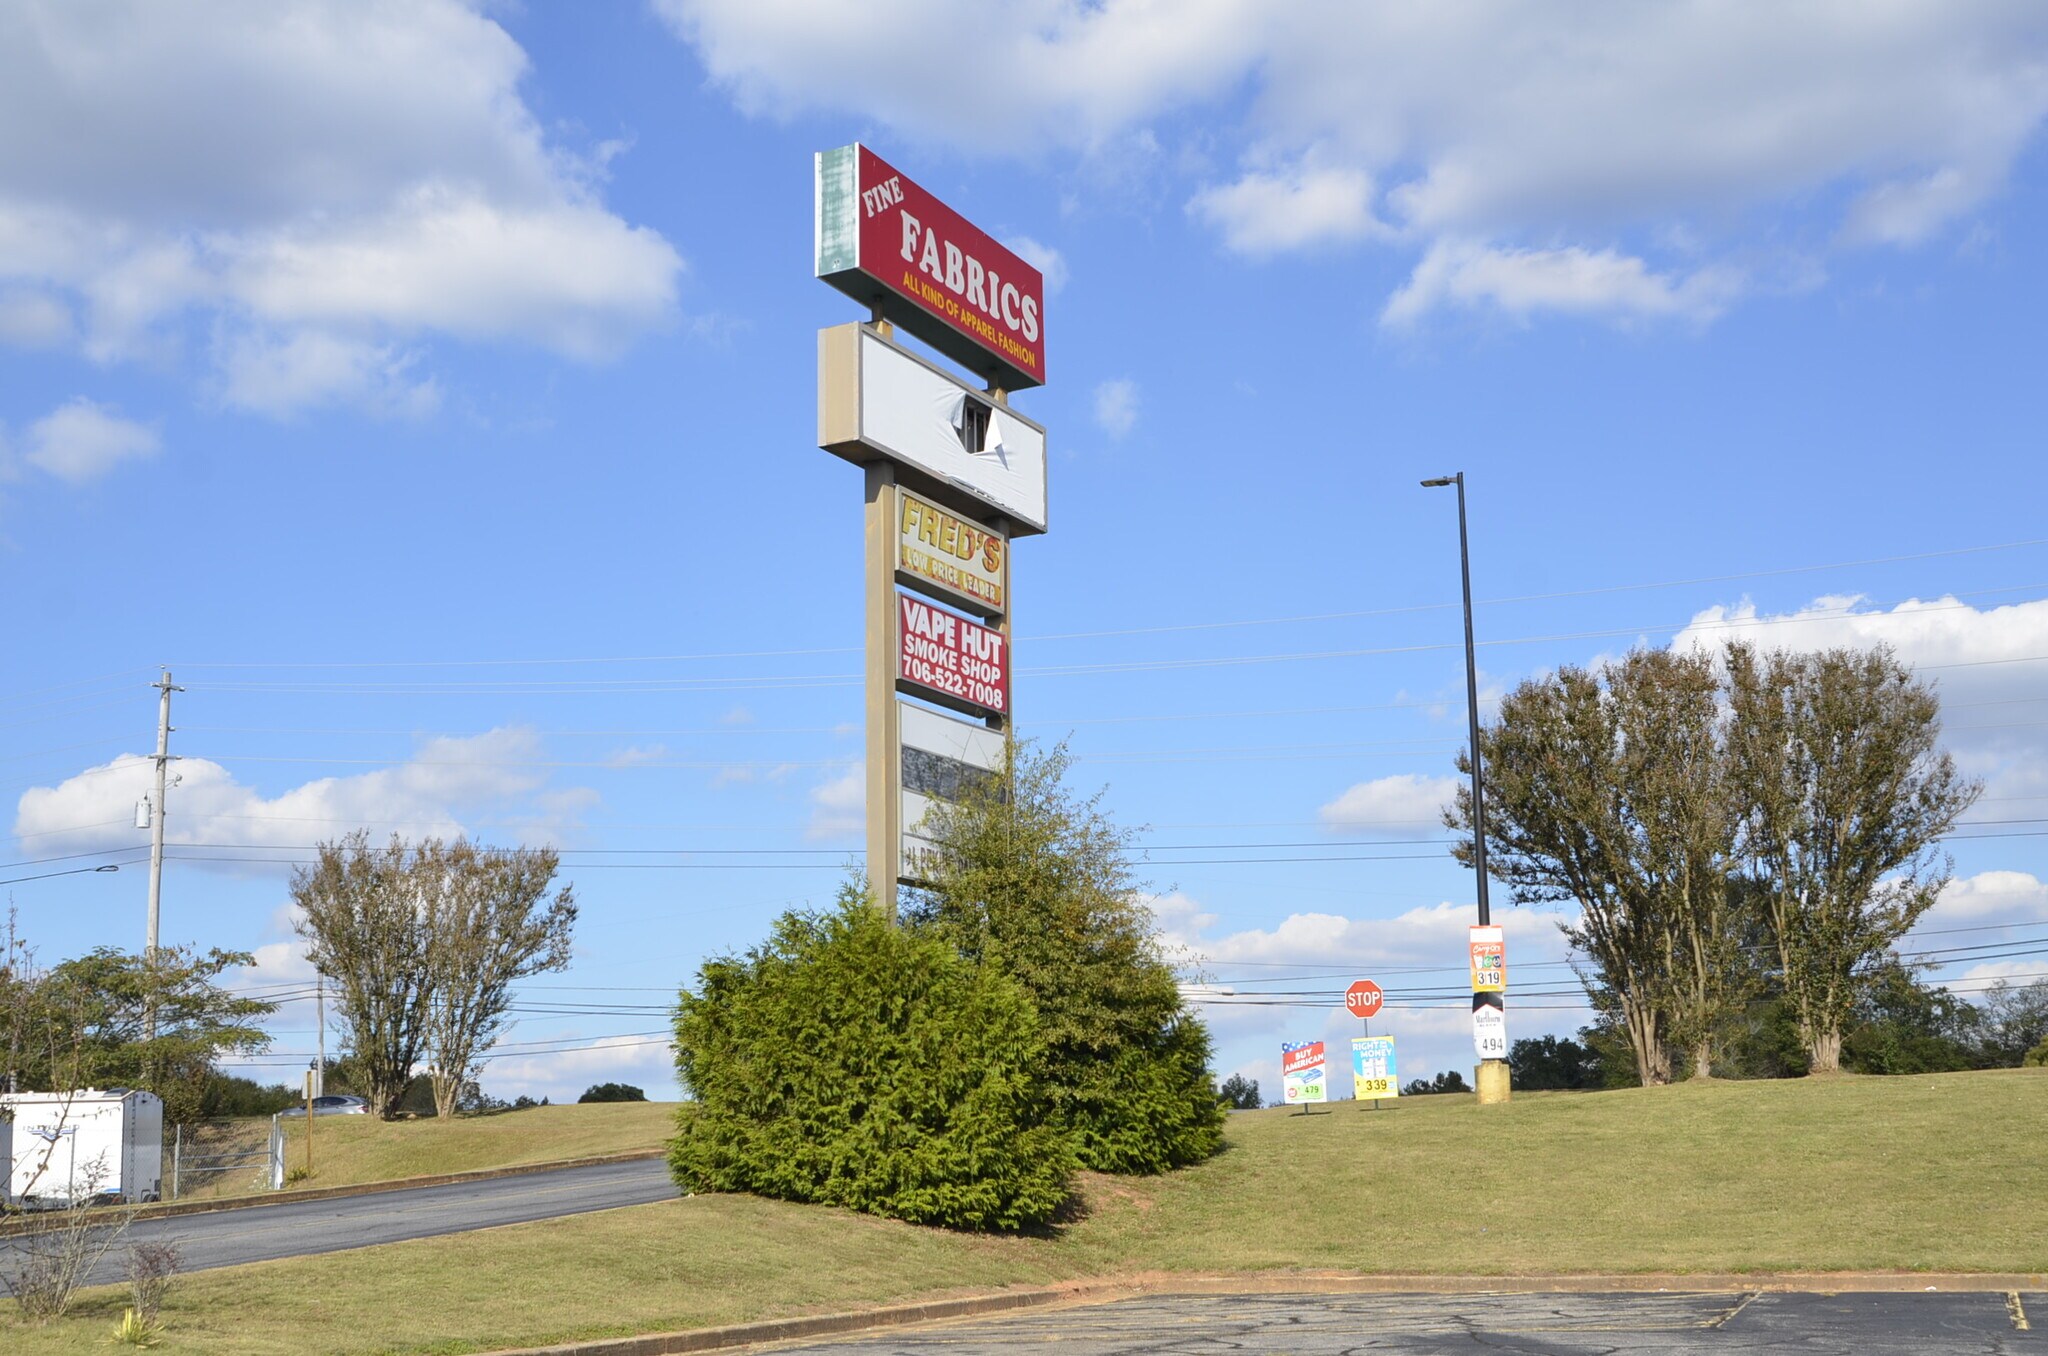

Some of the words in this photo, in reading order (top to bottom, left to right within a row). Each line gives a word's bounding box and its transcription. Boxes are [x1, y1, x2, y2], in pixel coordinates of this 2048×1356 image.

[862, 176, 904, 218] FINE
[900, 209, 1039, 342] FABRICS
[903, 271, 920, 294] ALL
[921, 281, 945, 310] KIND
[945, 299, 959, 318] OF
[960, 308, 998, 345] APPAREL
[998, 332, 1036, 368] FASHION
[902, 496, 1001, 573] FRED'S
[907, 548, 928, 571] LOW
[932, 560, 959, 585] PRICE
[963, 572, 996, 601] LEADER
[902, 597, 956, 648] VAPE
[962, 621, 1002, 665] HUT
[904, 633, 958, 671] SMOKE
[961, 655, 1001, 685] SHOP
[903, 654, 1003, 709] 706-522-7008
[1347, 991, 1381, 1007] STOP
[1284, 1053, 1324, 1073] AMERICAN
[1295, 1048, 1312, 1061] BUY
[1352, 1041, 1379, 1052] RIGHT
[1360, 1048, 1393, 1058] MONEY
[1482, 1038, 1503, 1051] 494
[1366, 1079, 1387, 1091] 339
